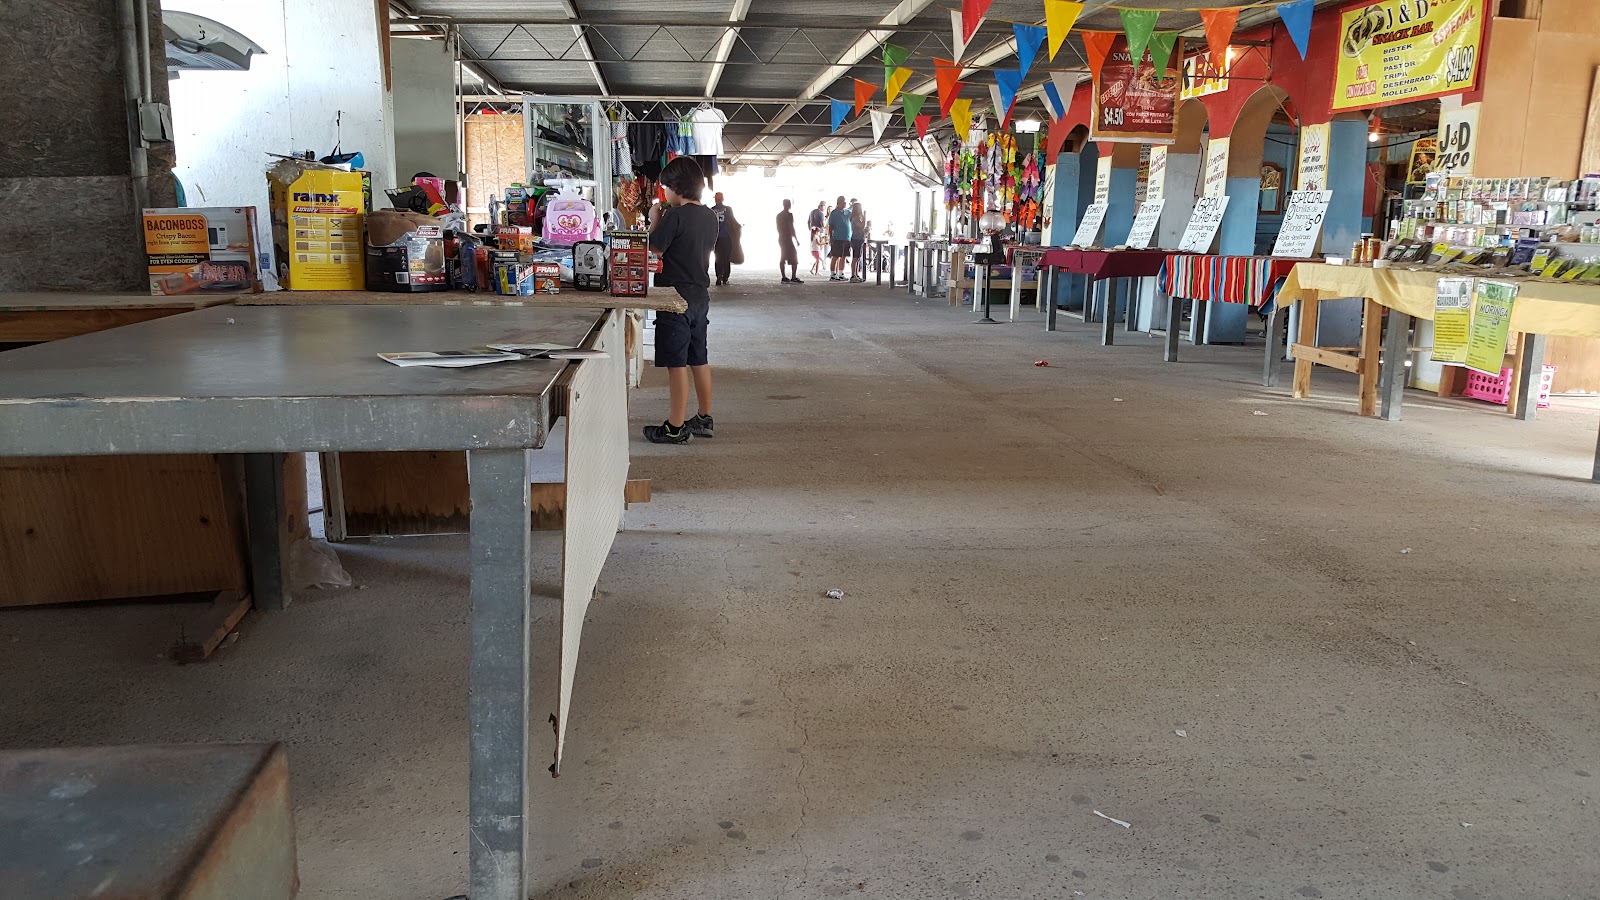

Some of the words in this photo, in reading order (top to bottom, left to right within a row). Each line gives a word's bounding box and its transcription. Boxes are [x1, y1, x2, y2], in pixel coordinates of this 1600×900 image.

[1399, 4, 1411, 24] &
[1415, 0, 1429, 19] D
[1433, 5, 1475, 46] ESPECIAL
[1372, 27, 1411, 46] SNACK
[1410, 21, 1434, 37] BAR
[1383, 44, 1413, 55] BISTEK
[1112, 52, 1146, 62] SNAK
[1383, 55, 1400, 63] BBQ
[1384, 61, 1416, 72] PASTOR
[1446, 44, 1474, 88] $4.99
[1384, 71, 1408, 80] TRIPA
[1381, 86, 1419, 98] MOLLEJA
[1104, 106, 1124, 127] $4.50
[1435, 151, 1470, 169] TACO
[146, 219, 204, 231] BACONBOSS
[156, 232, 177, 240] Crispy
[1480, 304, 1509, 318] MORINGA
